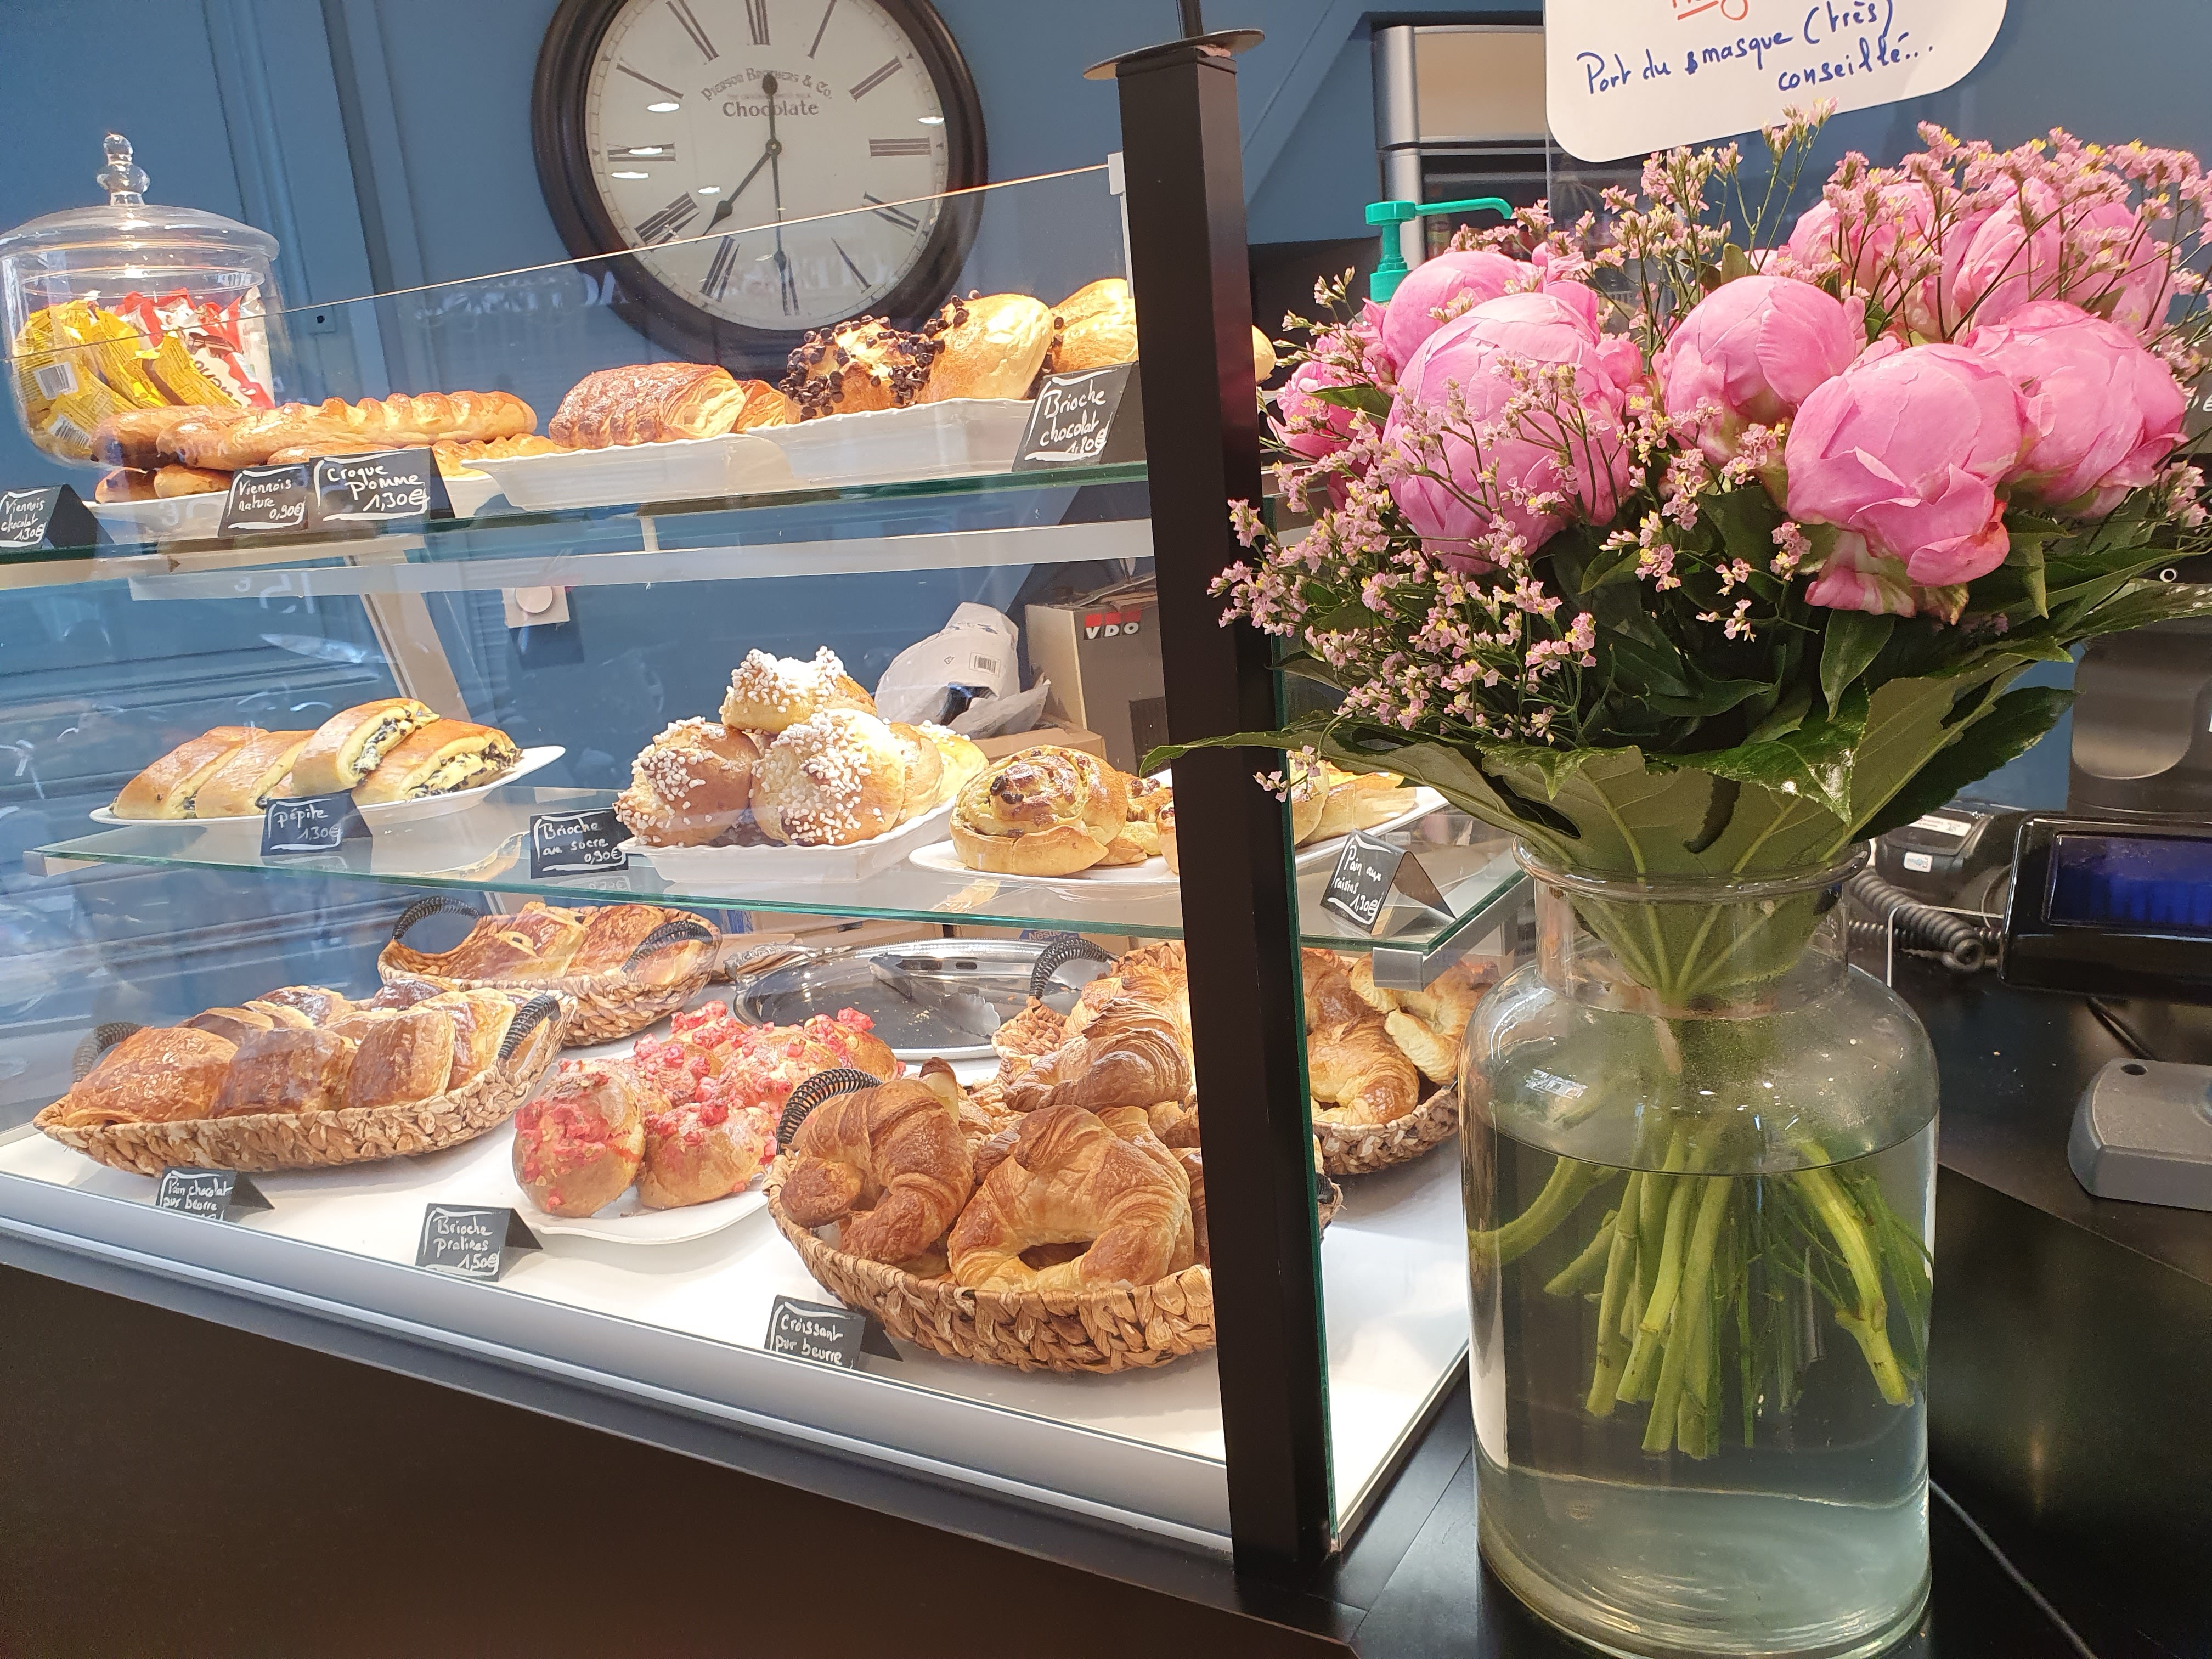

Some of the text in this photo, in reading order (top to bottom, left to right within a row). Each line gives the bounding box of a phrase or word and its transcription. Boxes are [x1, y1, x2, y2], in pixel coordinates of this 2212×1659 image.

[1576, 52, 1631, 94] Port
[1643, 48, 1671, 79] du
[1702, 32, 1793, 71] masque
[1804, 0, 1893, 44] (très)
[802, 75, 812, 88] &
[816, 81, 833, 99] Co.
[722, 100, 819, 117] Chocolate
[1043, 379, 1106, 419] Brioche
[1040, 410, 1099, 447] chocolat
[239, 479, 292, 496] Viennois
[5, 497, 45, 515] Viennois
[238, 495, 275, 511] nature
[363, 488, 431, 511] 1,30€
[269, 501, 305, 520] 0,90€
[1, 512, 39, 533] chocolat
[14, 523, 46, 541] 1,30€
[1085, 622, 1139, 639] VDO
[297, 823, 341, 840] 1,30€
[539, 817, 601, 840] Brioche
[543, 838, 608, 856] au sucre
[584, 848, 622, 865] 0,90€
[1344, 845, 1381, 882] Pain aux
[1334, 877, 1359, 894] raisins
[1350, 894, 1379, 917] 1,30€
[168, 1176, 233, 1198] Pain chocolat
[184, 1194, 218, 1211] beurre
[433, 1215, 493, 1236] Brioche
[458, 1253, 499, 1272] 1,50€
[781, 1314, 843, 1342] Croissant
[776, 1335, 843, 1365] pur beurre
